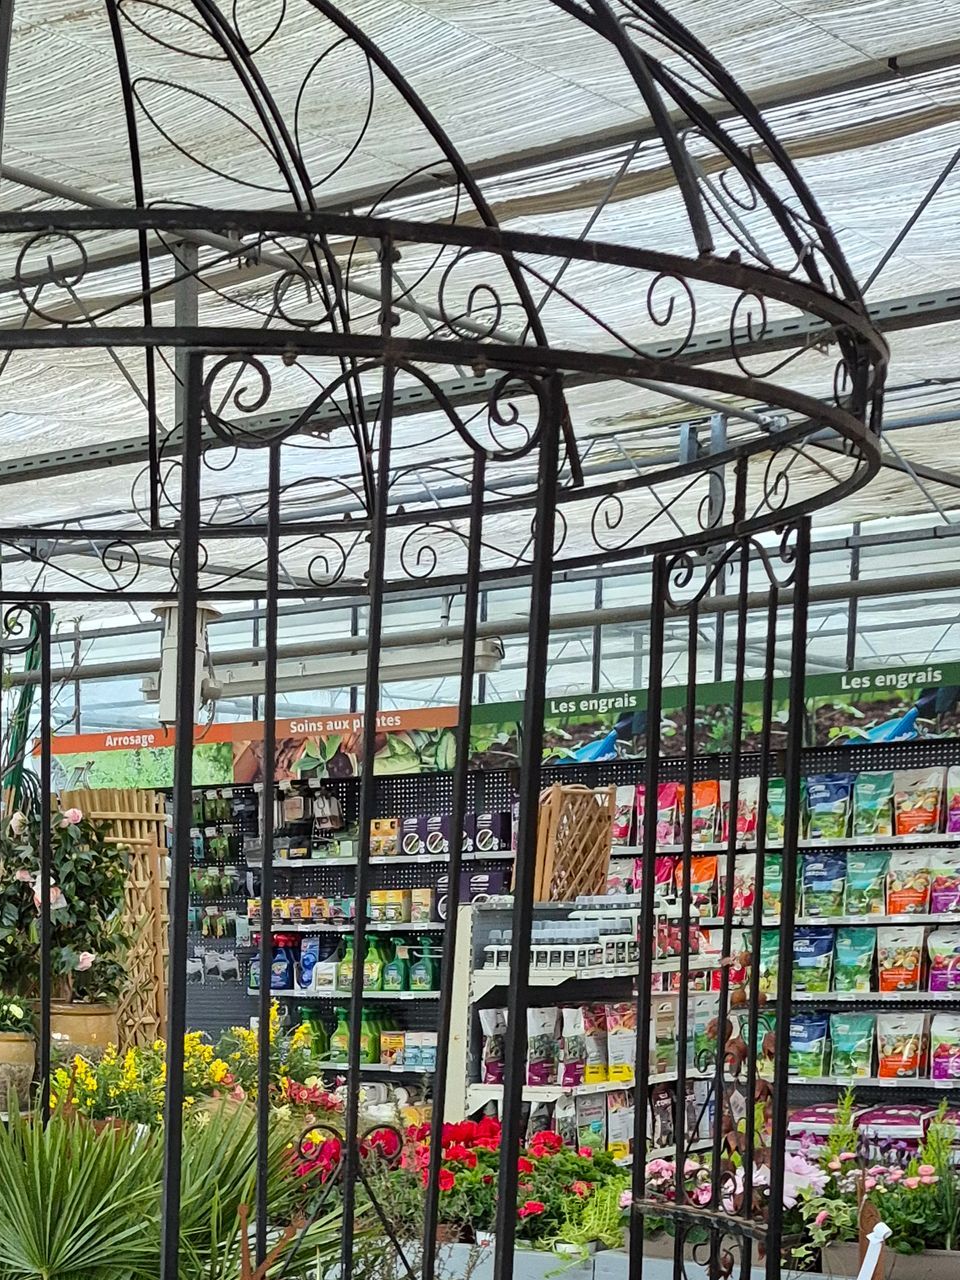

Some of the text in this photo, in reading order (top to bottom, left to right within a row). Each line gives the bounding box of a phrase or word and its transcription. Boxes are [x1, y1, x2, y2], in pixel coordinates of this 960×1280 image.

[841, 667, 942, 690] Les engrais
[550, 693, 637, 714] Les engrais
[289, 715, 401, 733] Soins aux plntes
[105, 734, 155, 747] Arrosage
